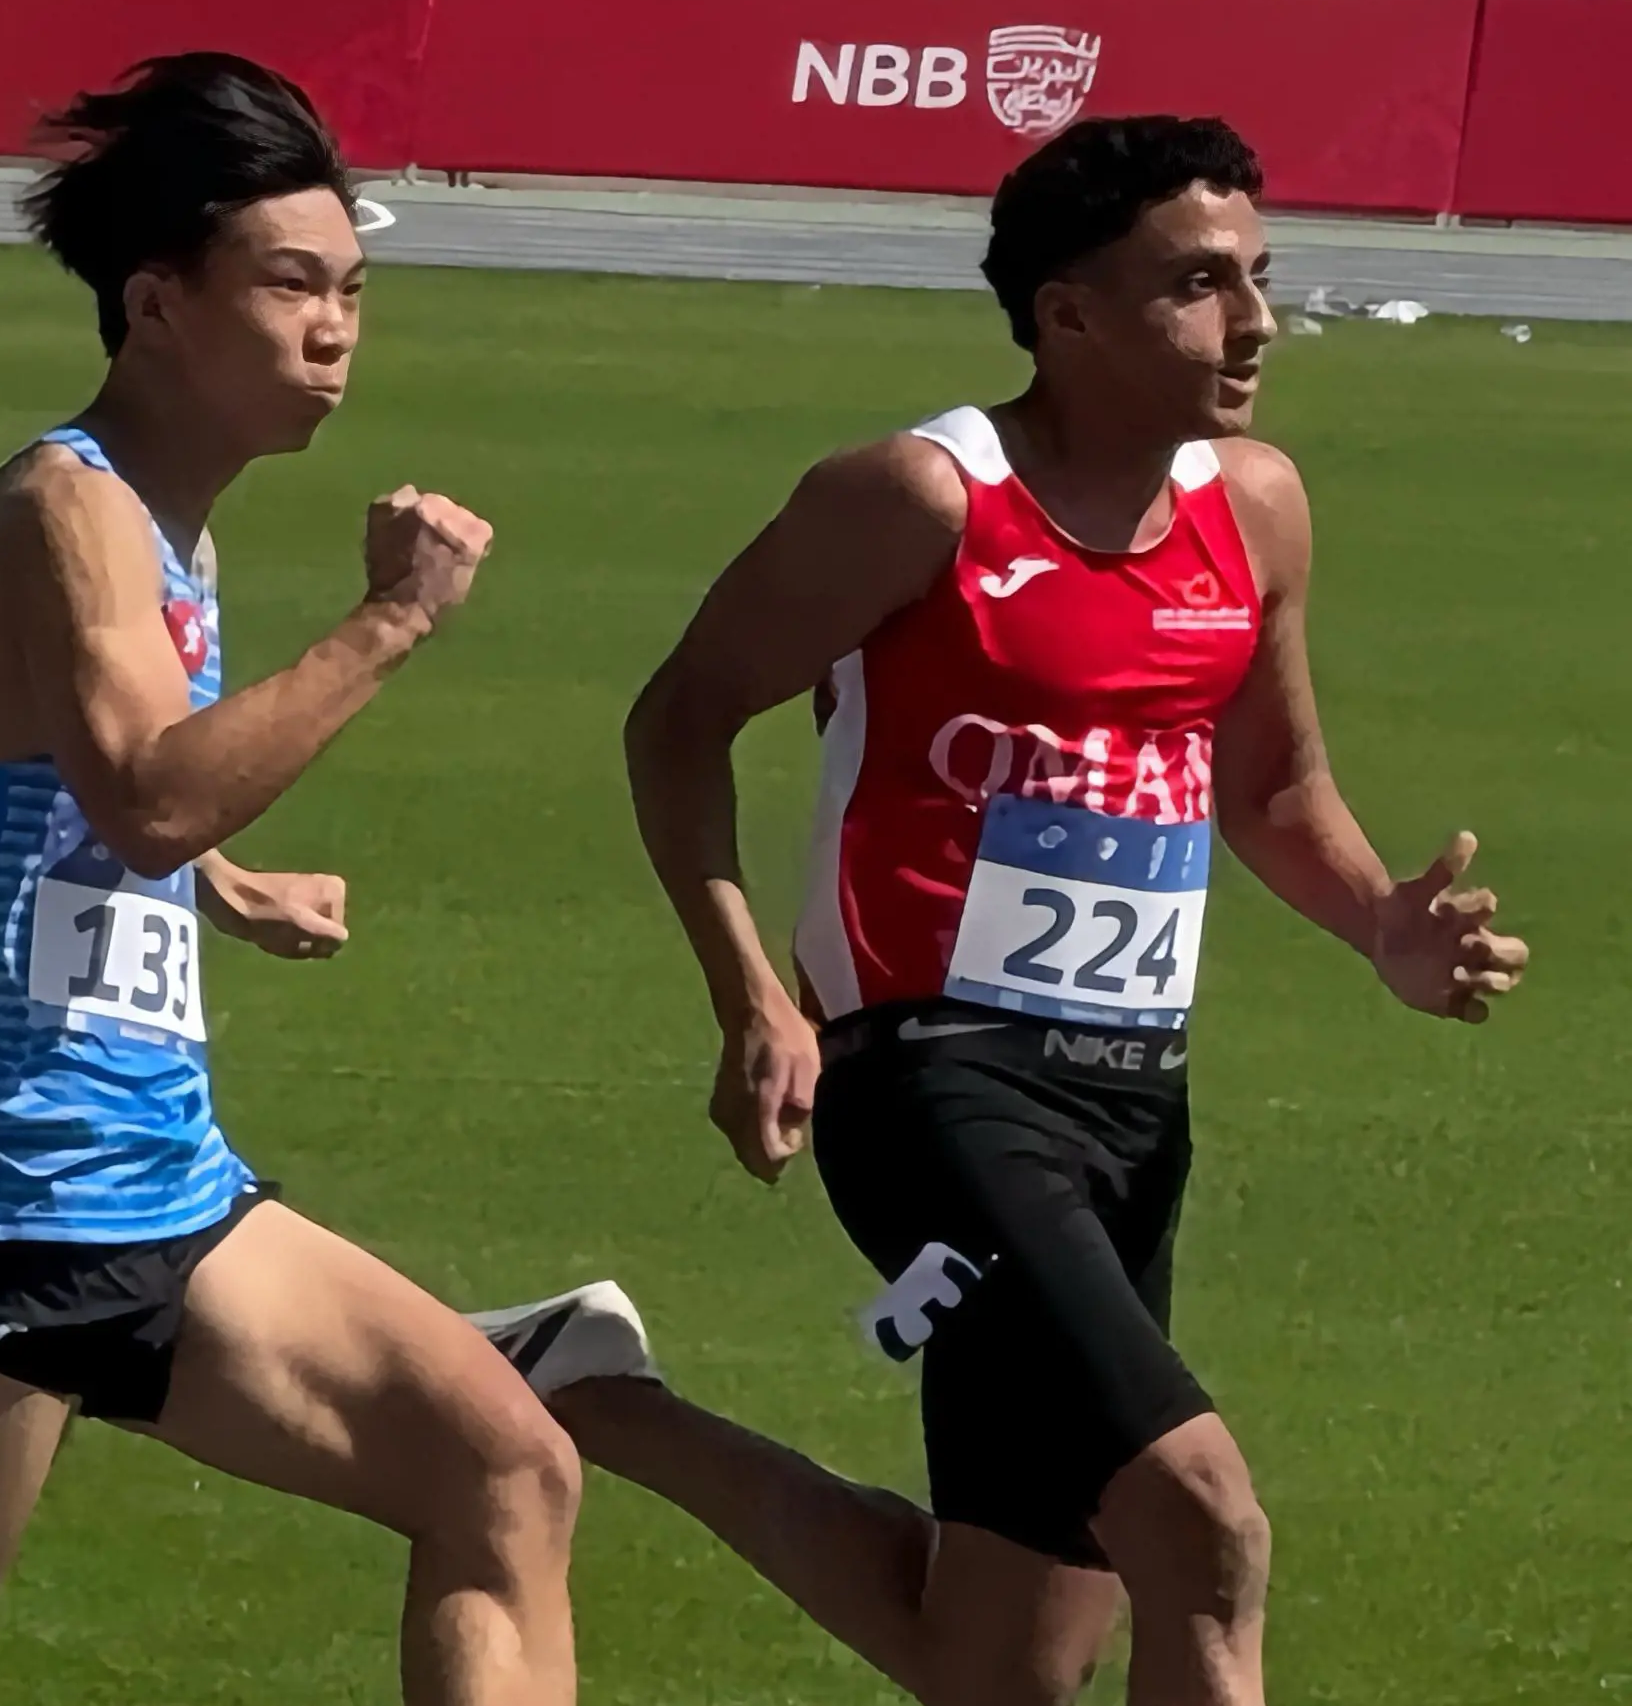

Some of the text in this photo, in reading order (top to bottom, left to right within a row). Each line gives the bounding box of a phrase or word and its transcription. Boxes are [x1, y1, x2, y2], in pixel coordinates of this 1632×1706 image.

[791, 39, 968, 110] NBB
[68, 904, 189, 1021] 133
[1002, 887, 1180, 996] 224
[1044, 1028, 1146, 1070] NIKE
